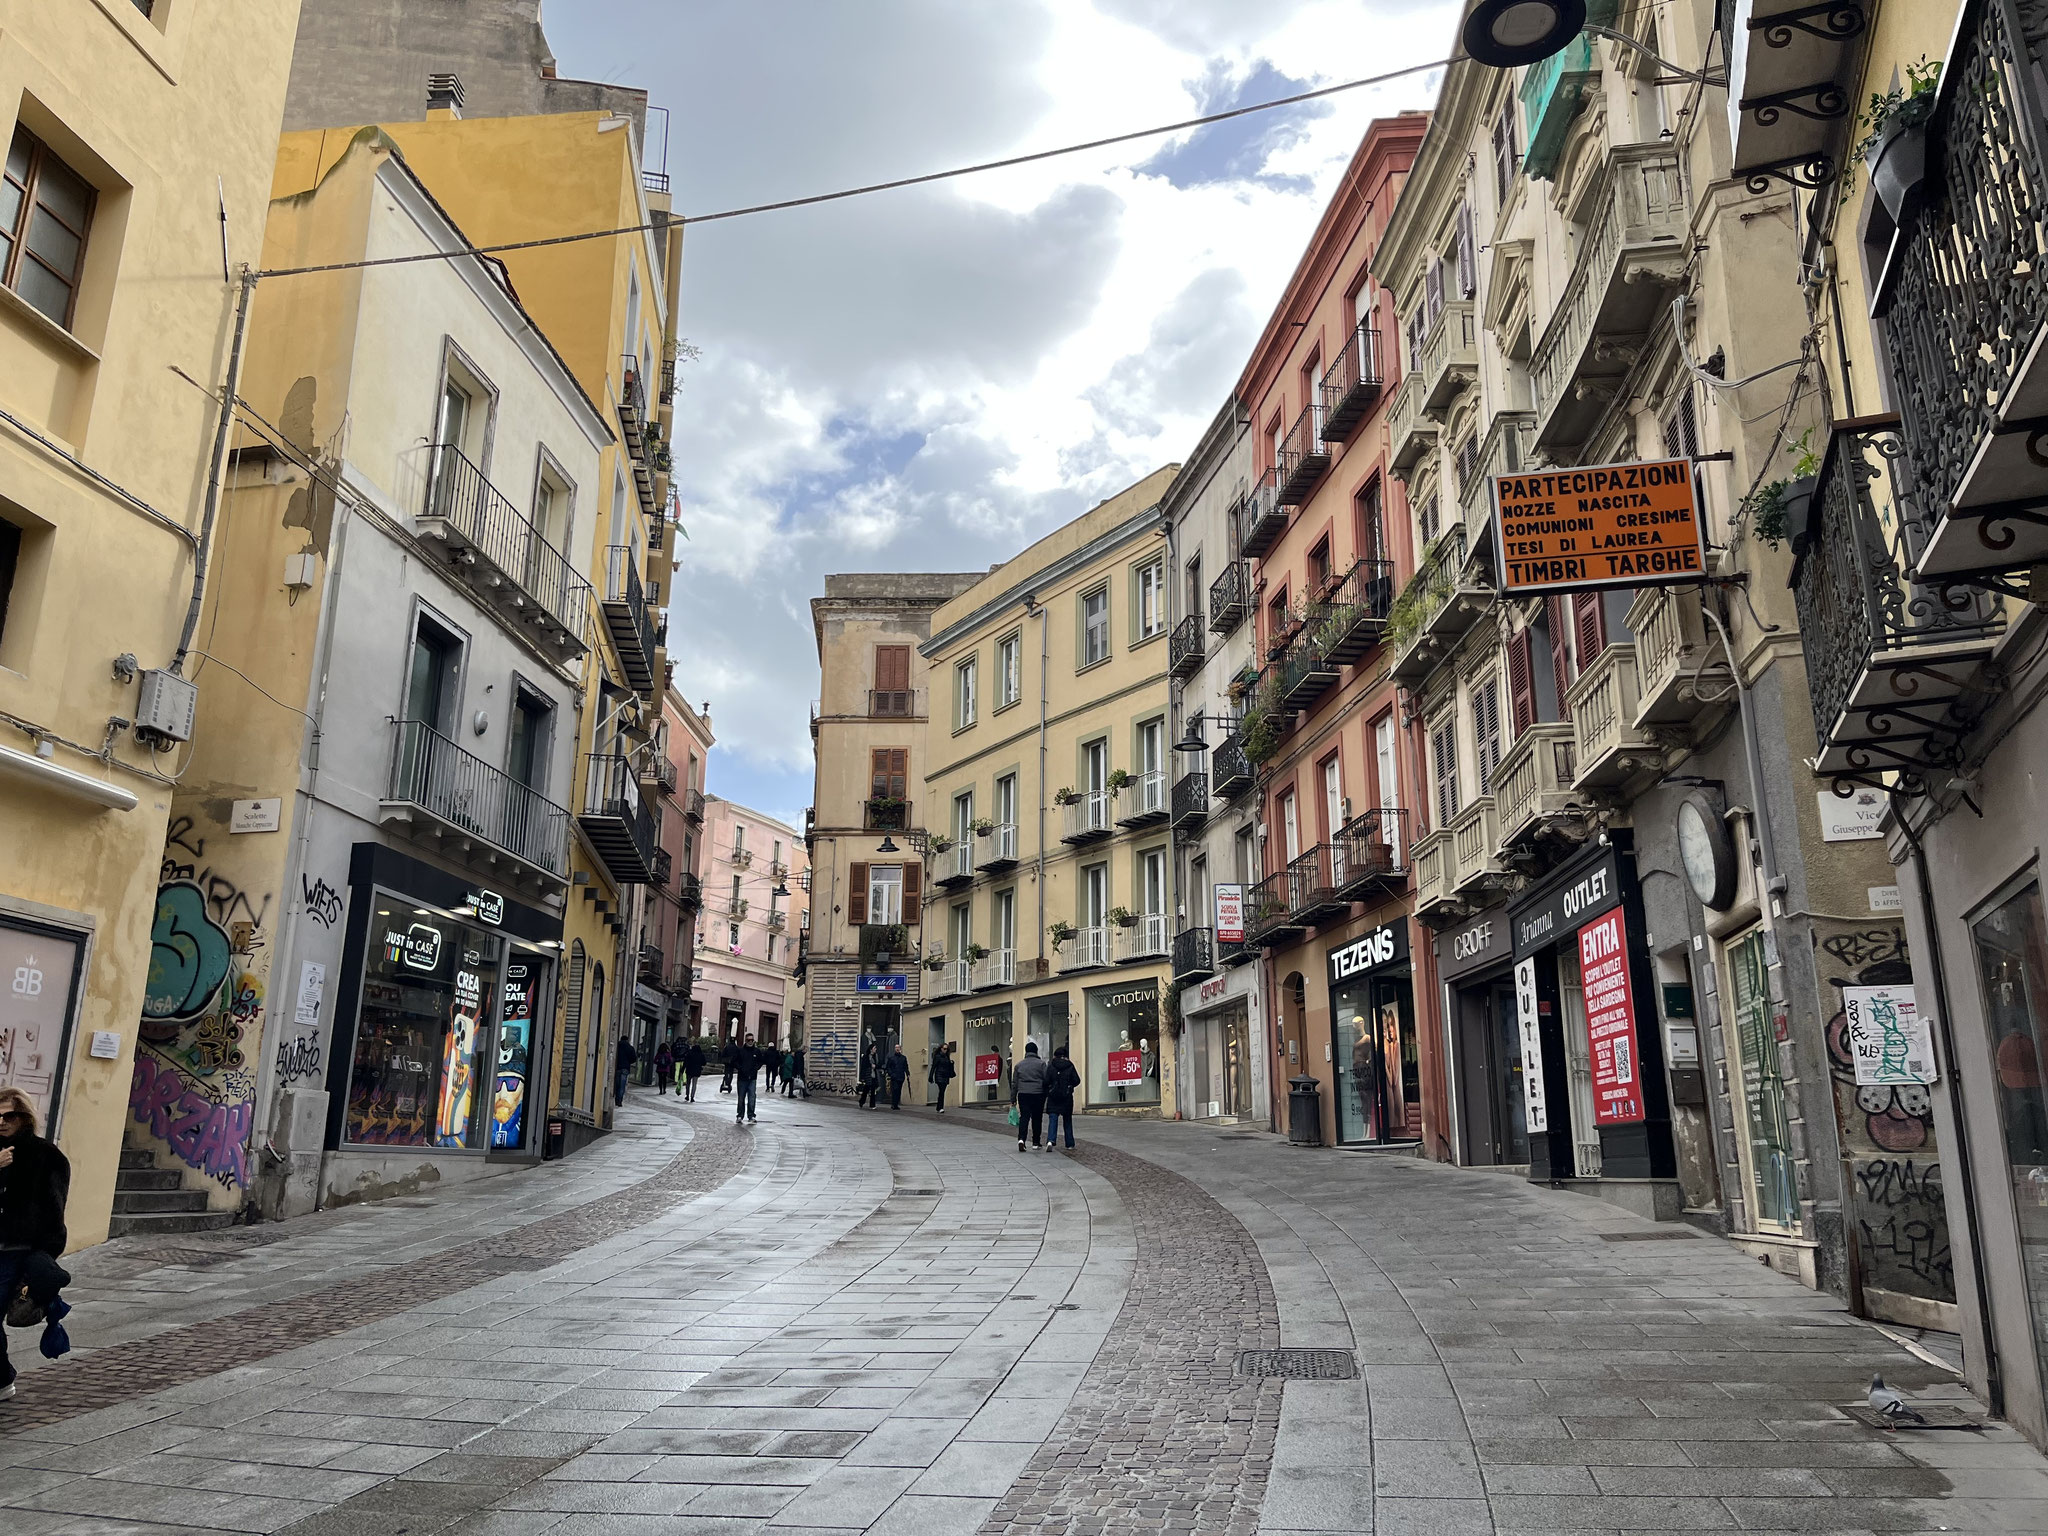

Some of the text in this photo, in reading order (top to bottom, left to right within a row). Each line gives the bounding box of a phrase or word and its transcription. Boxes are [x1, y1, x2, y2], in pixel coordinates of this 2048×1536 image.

[1500, 464, 1686, 500] PARTECIPAZIONI
[1503, 493, 1651, 518] NOZZE NASCITA
[1504, 508, 1691, 537] COMUNIONI CRESIME
[1507, 530, 1663, 556] TESI DI LAUREA
[1509, 549, 1698, 584] TIMBRI TARGHE
[1832, 824, 1873, 836] Giuseppe
[1563, 867, 1607, 918] OUTLET
[486, 901, 499, 914] CASE
[1454, 920, 1493, 961] CROFF
[1520, 910, 1553, 946] Arianna
[386, 931, 434, 955] JUST in CASE
[1582, 917, 1620, 966] ENTRA
[457, 970, 480, 993] CREA
[866, 977, 897, 986] Castello
[505, 992, 527, 1001] EATE
[1112, 989, 1155, 1005] motivi
[966, 1016, 994, 1028] motivi
[1520, 966, 1538, 1128] OUTLET
